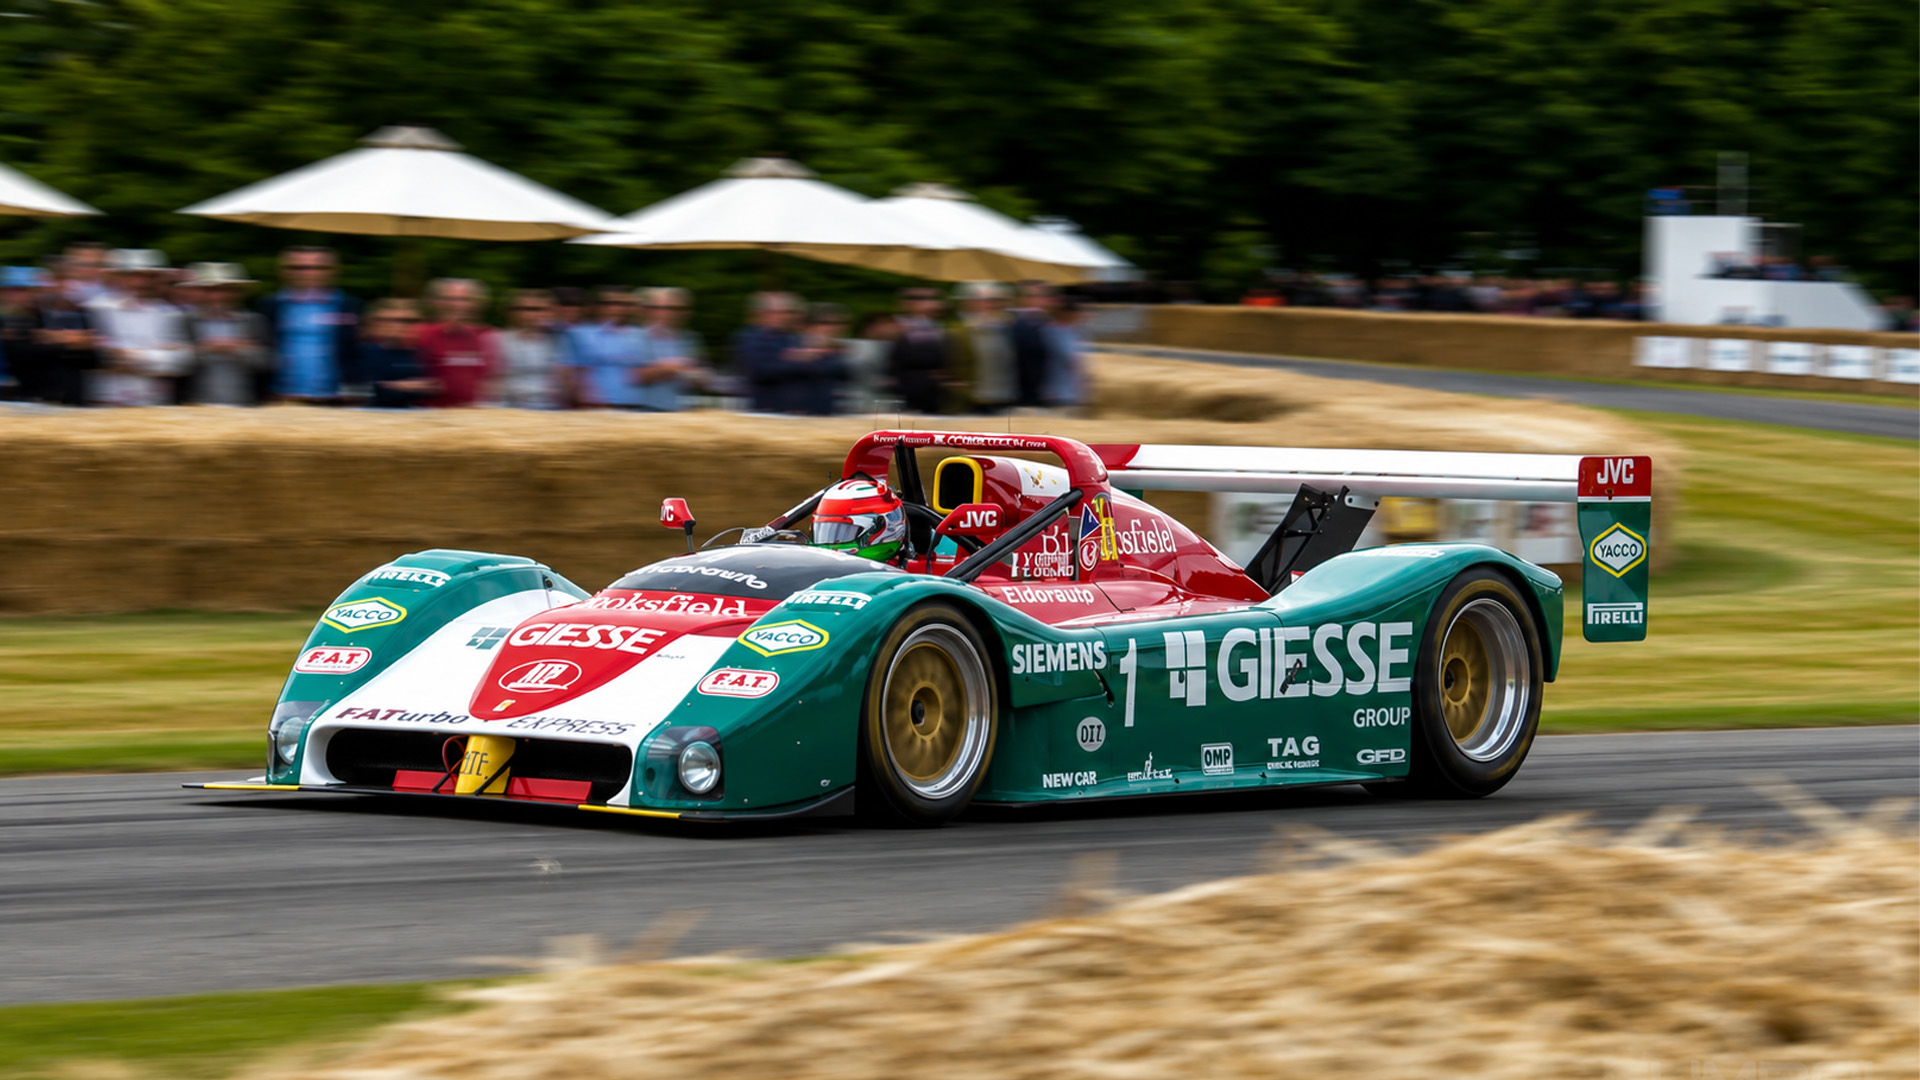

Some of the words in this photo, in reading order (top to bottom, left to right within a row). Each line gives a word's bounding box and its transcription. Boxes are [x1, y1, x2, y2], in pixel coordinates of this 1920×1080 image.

[1597, 458, 1634, 484] JVC
[960, 510, 997, 528] JVC
[1600, 543, 1638, 558] YACCO
[1001, 586, 1095, 605] Eldorauto
[335, 609, 392, 620] YACCO
[1587, 602, 1643, 624] PIRELLI
[509, 623, 667, 655] GIESSE
[755, 631, 814, 645] YACCO
[1012, 641, 1108, 675] SIEMENS
[1217, 621, 1413, 701] GIESSE
[1119, 638, 1137, 727] 1
[336, 706, 470, 724] FATurbo
[507, 716, 636, 736] EXPRESS
[1353, 707, 1411, 728] GROUP
[1204, 748, 1231, 767] OMP
[1267, 736, 1320, 758] TAG
[1042, 772, 1074, 788] NEW
[1075, 771, 1097, 786] CAR
